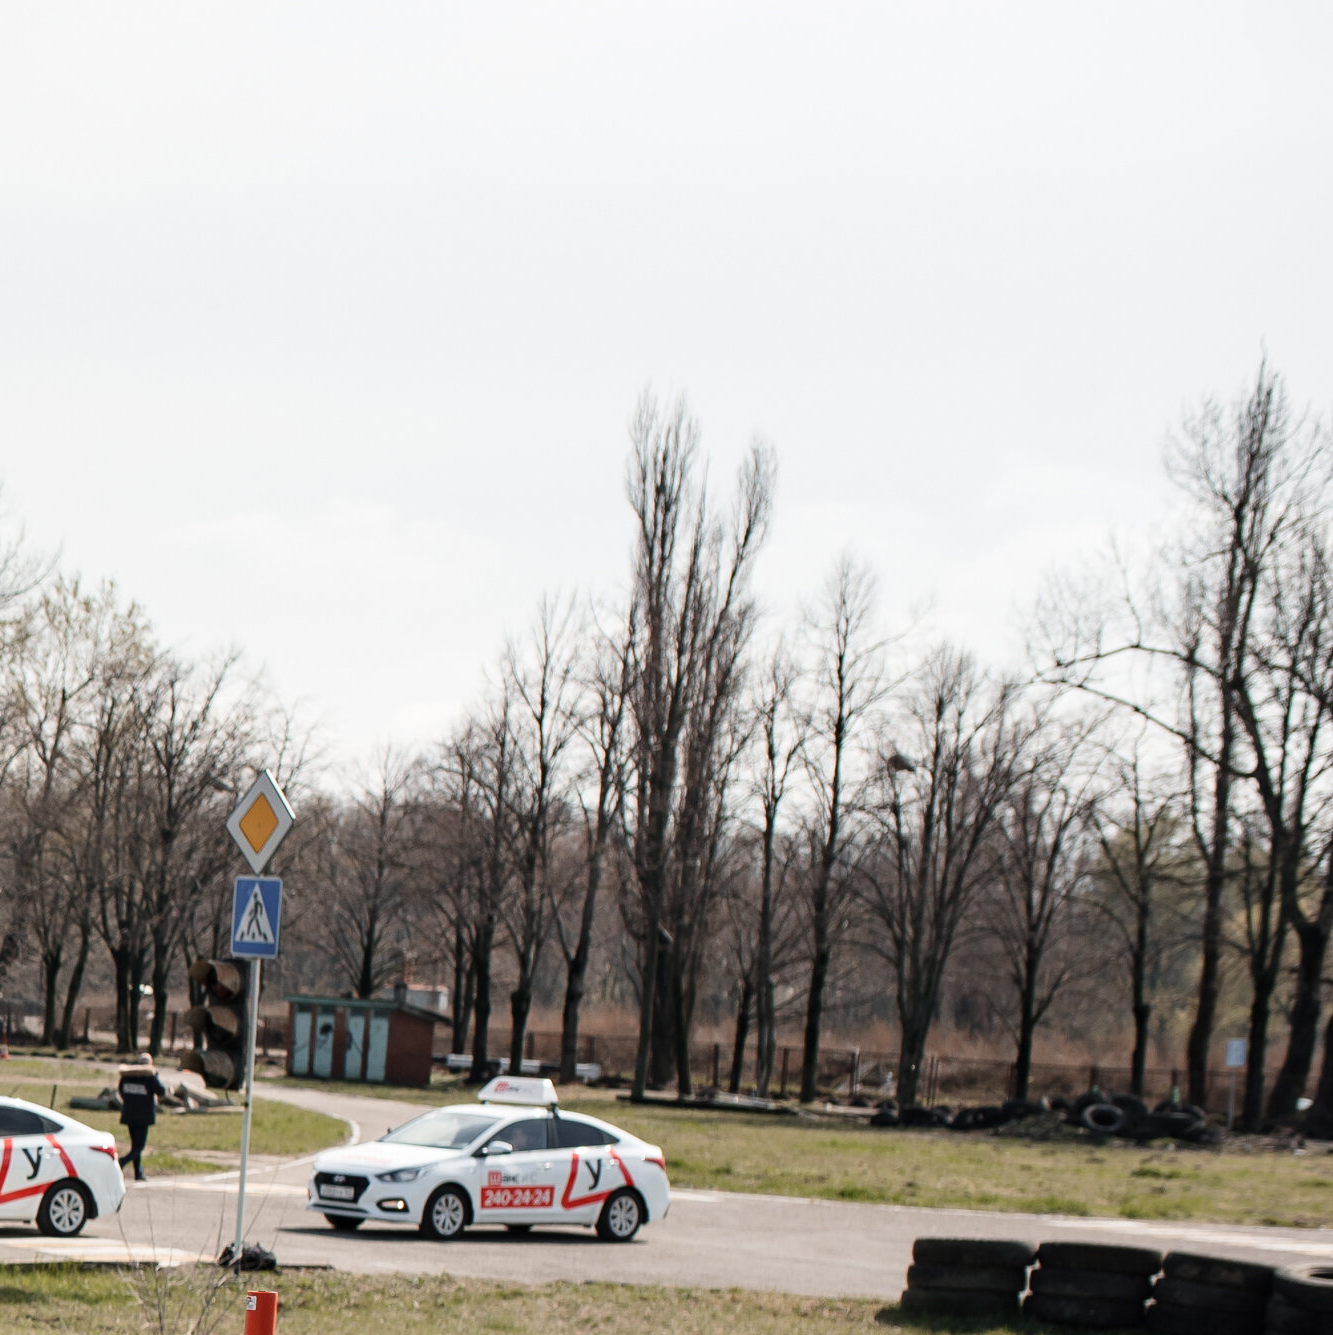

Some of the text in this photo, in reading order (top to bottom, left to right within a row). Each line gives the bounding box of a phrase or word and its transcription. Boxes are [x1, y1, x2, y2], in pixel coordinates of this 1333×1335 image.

[21, 1146, 44, 1181] У
[584, 1158, 603, 1191] У
[484, 1188, 551, 1207] 240-24-24
